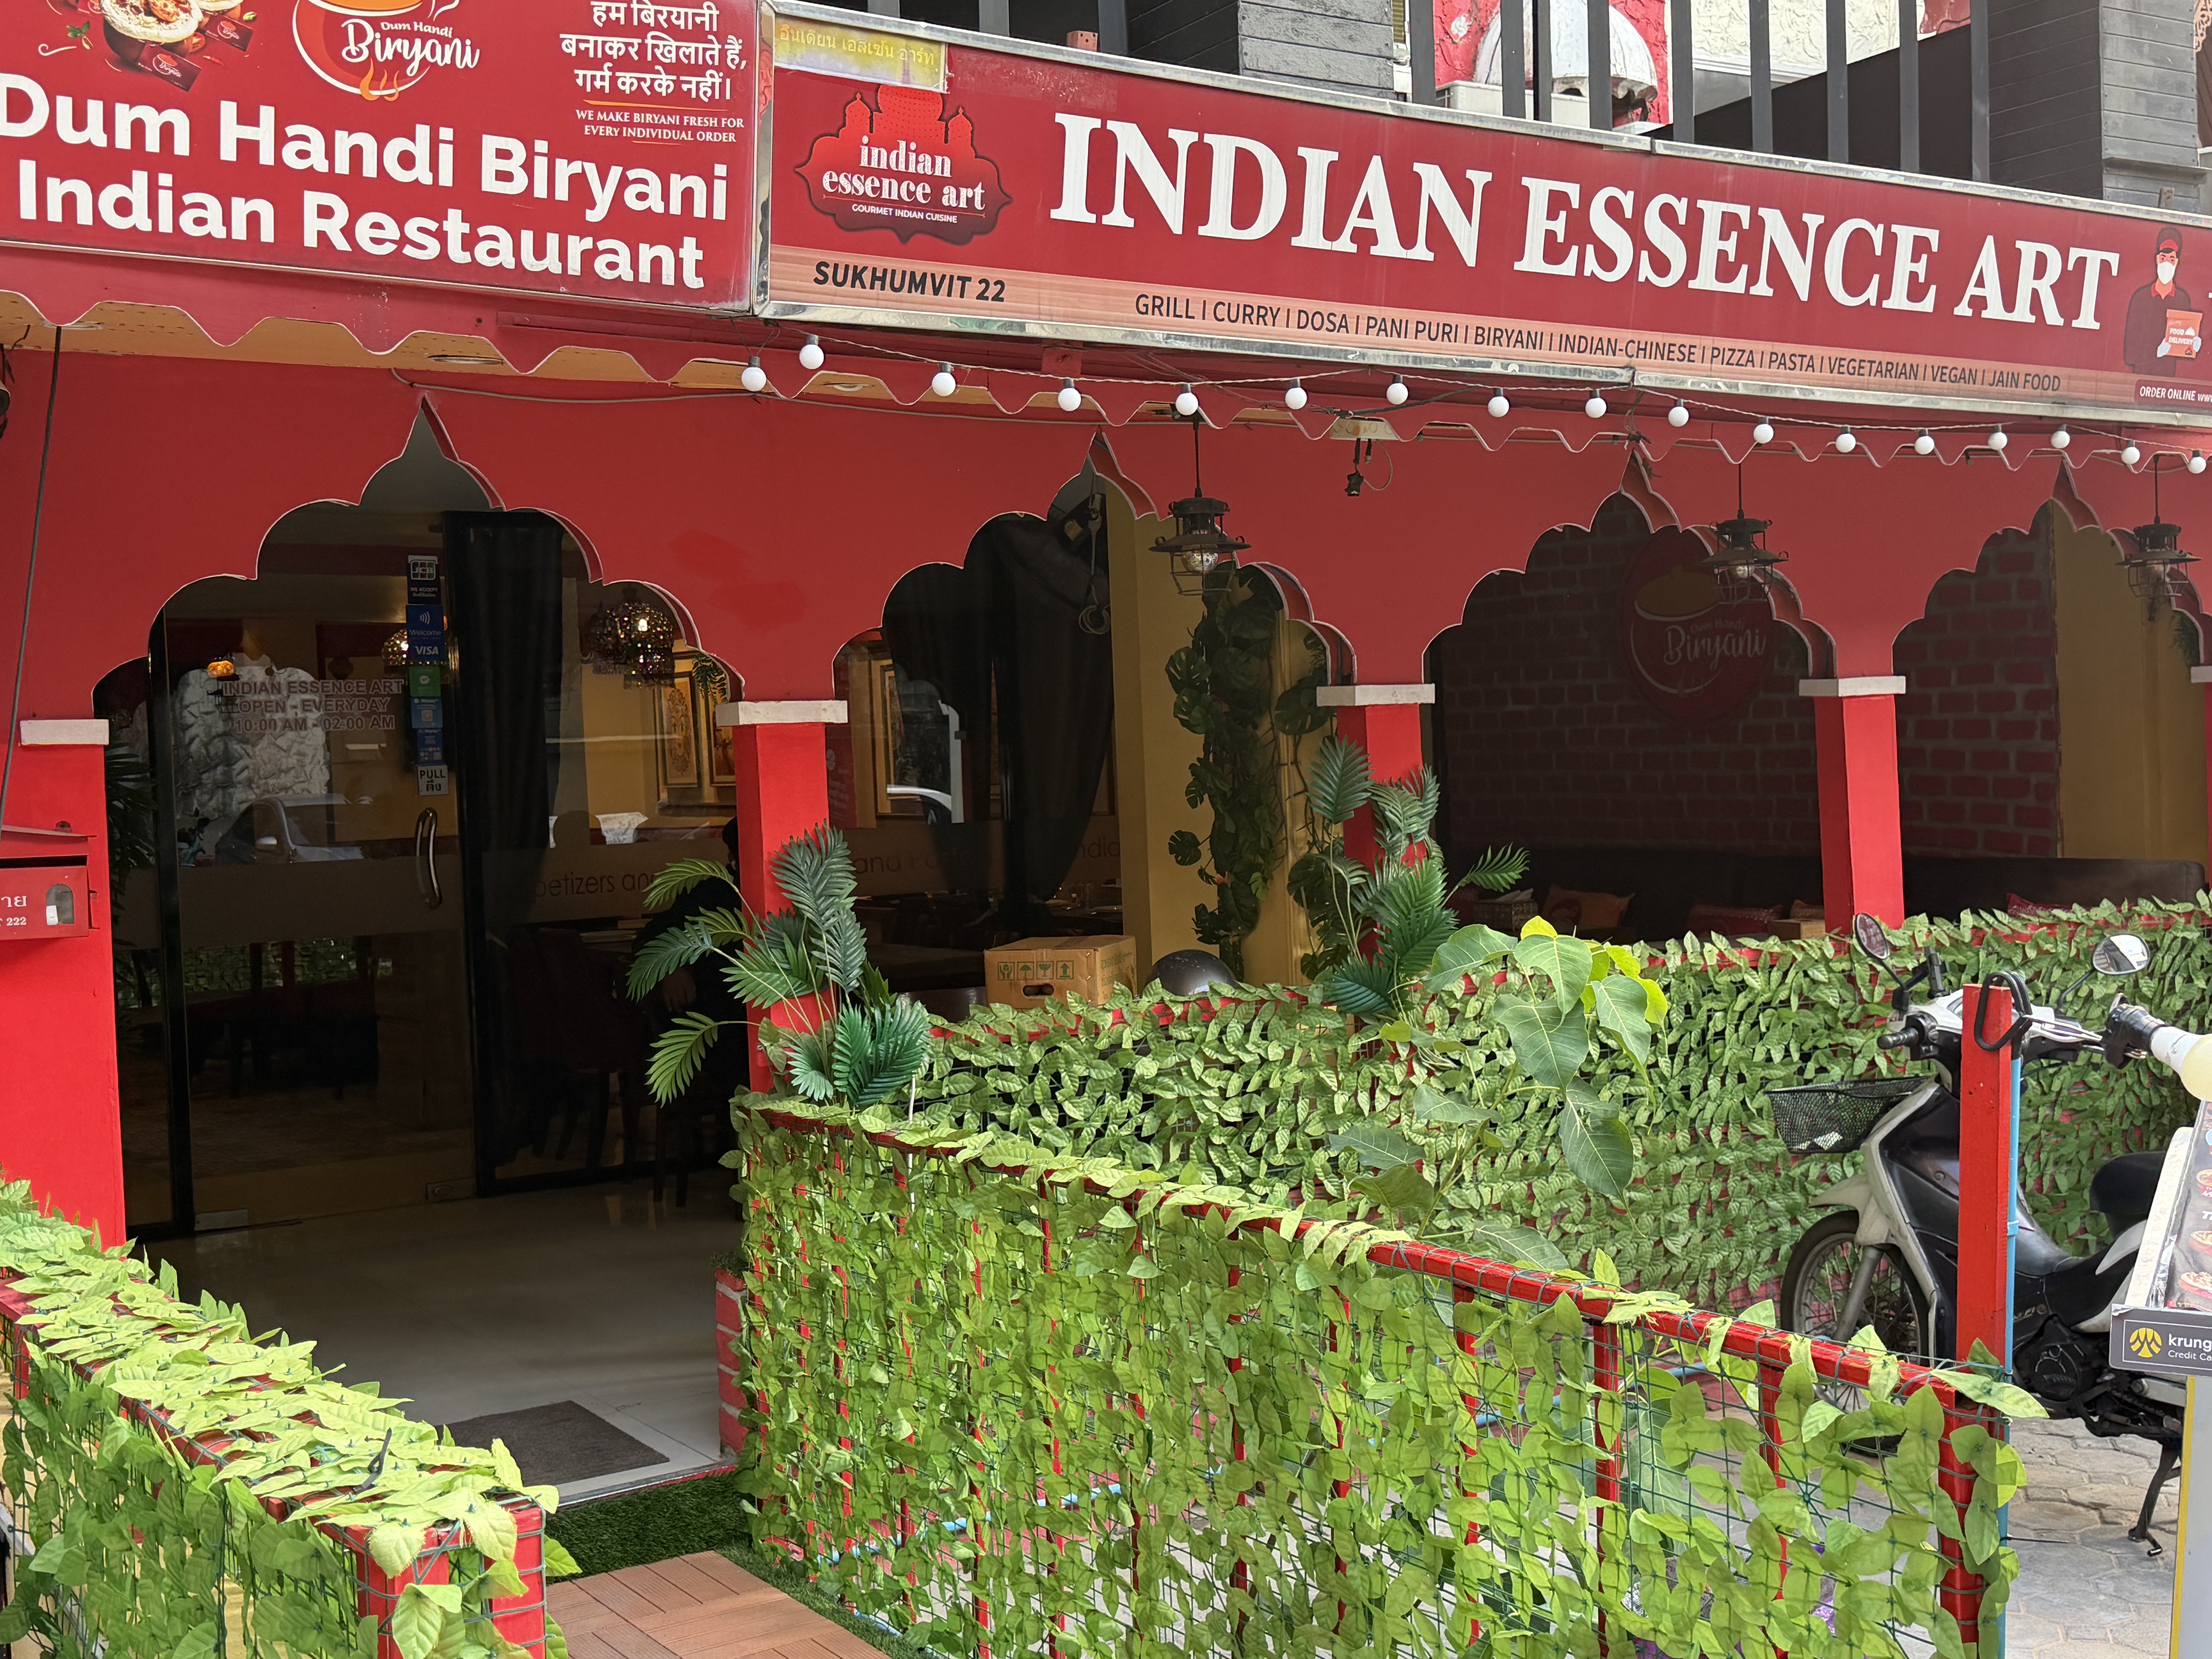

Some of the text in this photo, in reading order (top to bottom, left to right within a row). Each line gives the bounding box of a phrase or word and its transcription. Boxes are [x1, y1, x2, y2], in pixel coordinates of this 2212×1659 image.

[591, 0, 720, 31] हम बिरयानी
[381, 21, 453, 38] Dum Handi
[341, 18, 480, 76] Biryani
[560, 31, 747, 69] बनाकर खिलाते हैं,
[574, 62, 613, 93] गर्म
[615, 65, 677, 96] करके
[576, 110, 744, 129] WE MAKE BIRYANI FRESH FOR
[584, 125, 736, 143] EVERY INDIVIDUAL ORDER
[0, 73, 727, 222] Dum Handi Biryani
[859, 136, 952, 178] indian
[823, 170, 986, 211] essence art
[852, 204, 957, 224] GOURMET INDIAN CUISINE
[1050, 113, 2119, 330] INDIAN ESSENCE ART
[20, 160, 704, 289] Indian Restaurant
[813, 261, 1006, 303] SUKHUMVIT 22
[2170, 328, 2185, 336] FOOD
[1135, 293, 1195, 320] GRILL
[1213, 301, 1281, 327] CURRY
[1297, 309, 1350, 334] DOSA
[1365, 316, 1408, 339] PANI
[1415, 320, 1458, 343] PURI
[1474, 326, 1544, 351] BIRYANI
[1559, 333, 1697, 363] INDIAN-CHINESE
[1711, 346, 1755, 368] PIZZA
[1768, 351, 1815, 373] PASTA
[1828, 356, 1918, 381] VEGETARIAN
[1931, 365, 1977, 385] VEGAN
[1988, 369, 2019, 388] JAIN
[2023, 373, 2061, 392] FOOD
[2140, 386, 2166, 398] ORDER
[2167, 388, 2196, 401] ONLINE
[415, 646, 439, 655] VISA
[1663, 625, 1766, 671] Biryani
[223, 681, 281, 696] INDIAN
[287, 680, 366, 694] ESSENCE
[370, 679, 404, 694] ART
[239, 699, 287, 713] OPEN
[300, 697, 390, 713] EVERYDAY
[234, 718, 277, 732] 10:00
[278, 718, 307, 732] AM
[322, 716, 364, 731] 02:00
[369, 715, 395, 730] AM
[419, 770, 446, 780] PULL
[6, 917, 27, 926] 222
[2169, 1333, 2212, 1352] krung
[2168, 1350, 2197, 1360] Credit
